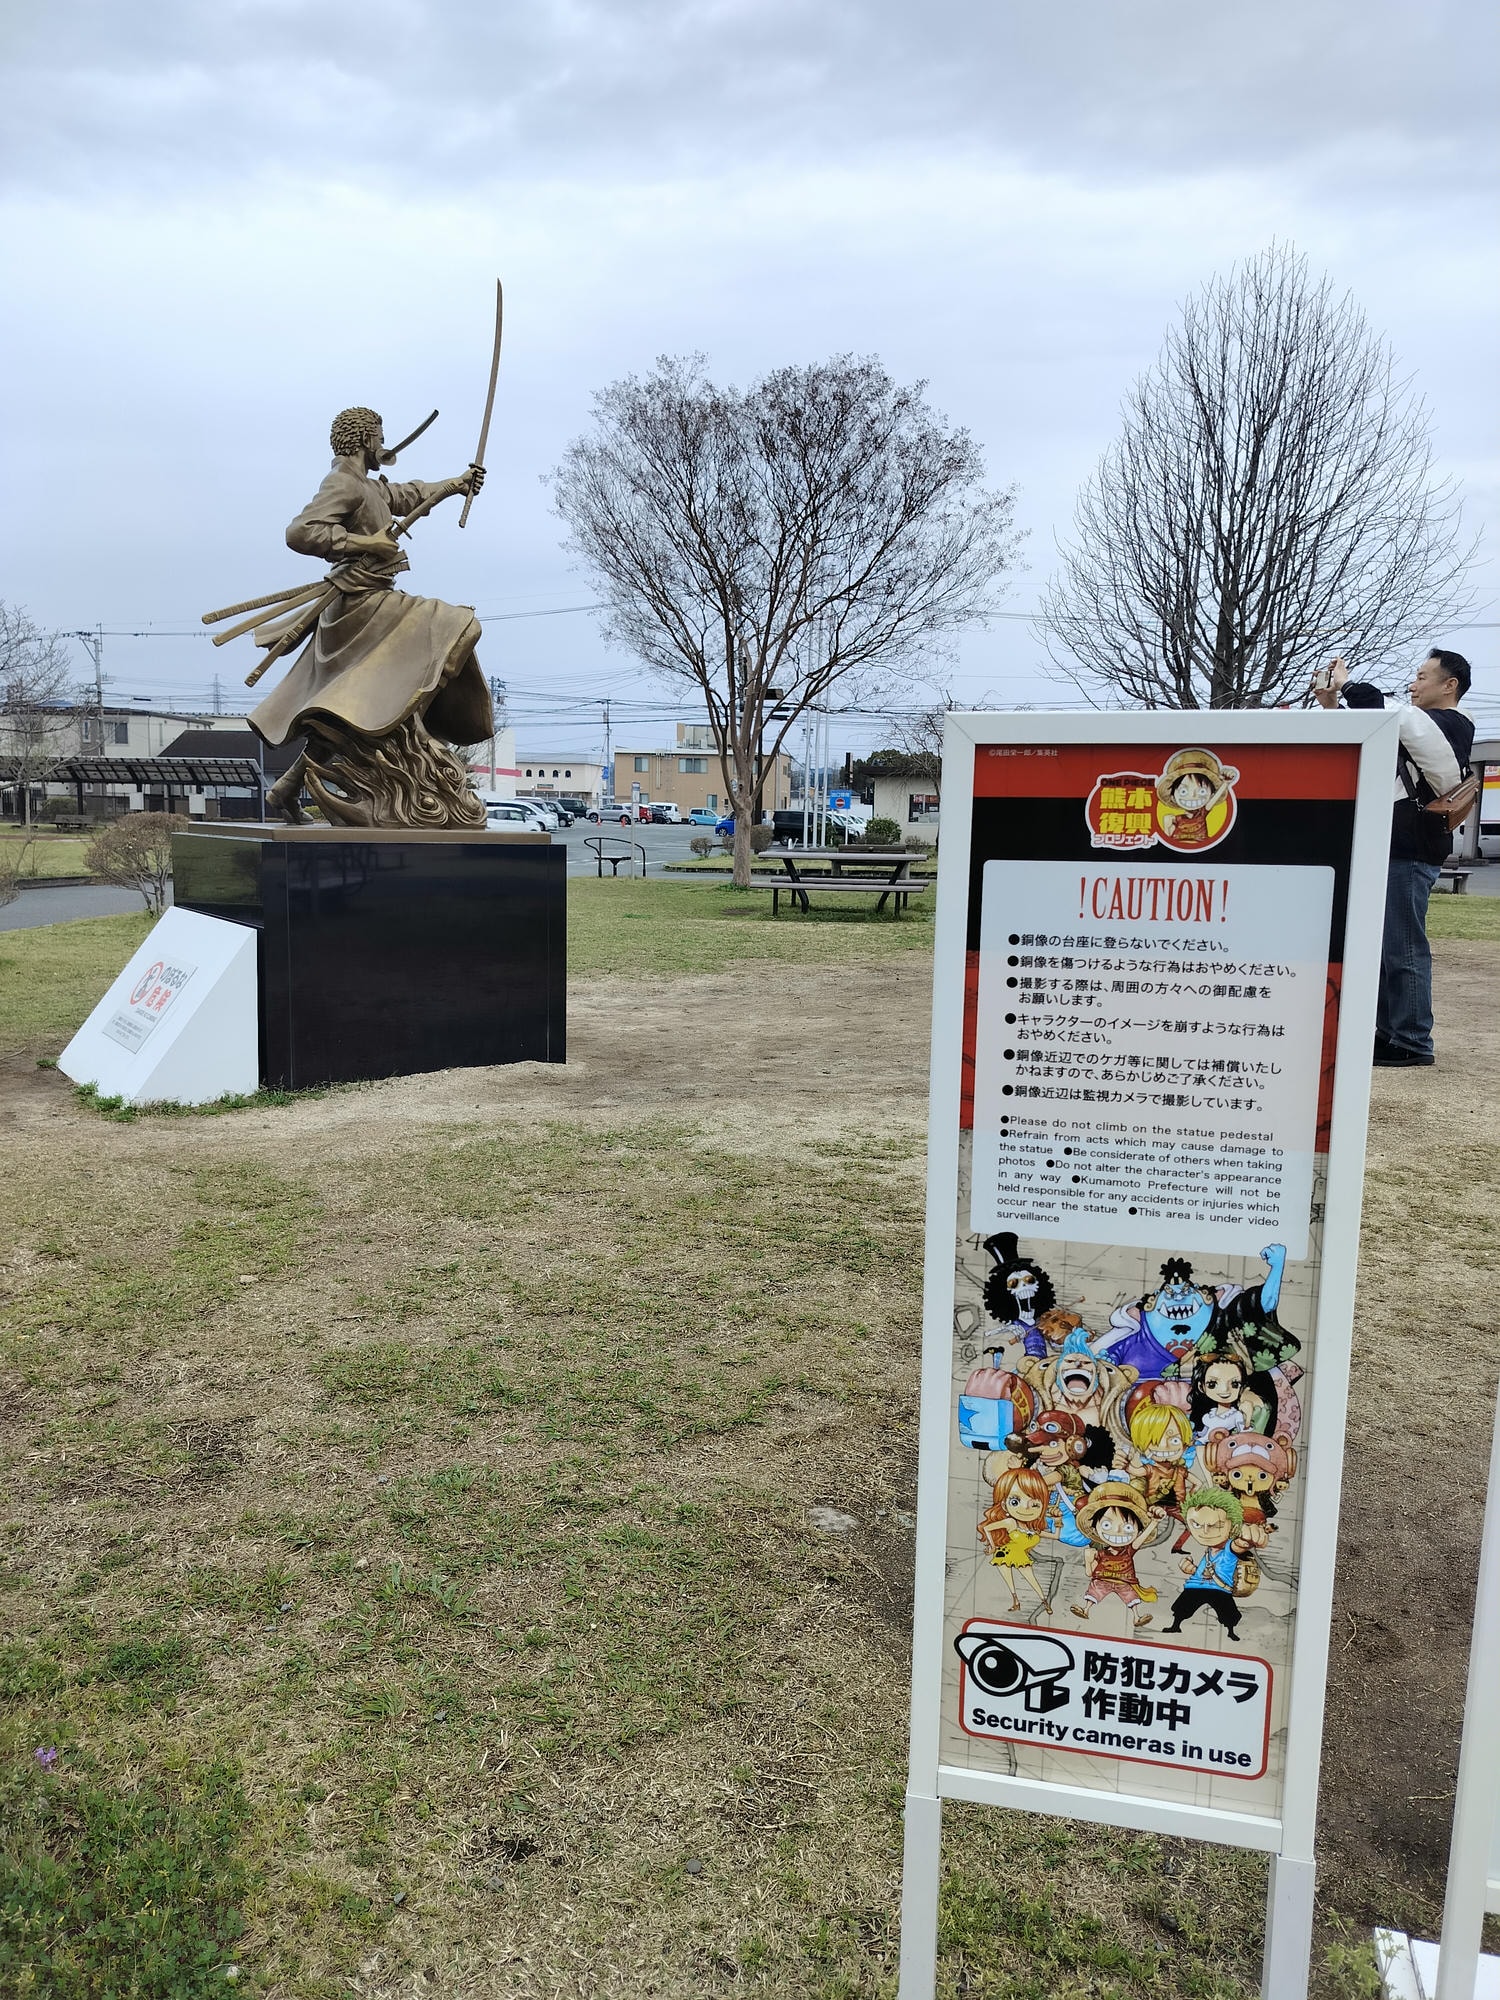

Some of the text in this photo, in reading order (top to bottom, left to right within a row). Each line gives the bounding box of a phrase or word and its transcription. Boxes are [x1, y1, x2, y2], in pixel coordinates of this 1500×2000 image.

[1100, 788, 1153, 809] 熊本
[1099, 813, 1152, 834] 復興
[1094, 834, 1155, 845] プロジェクト
[1010, 1116, 1273, 1141] Please do not climb on the statue pedestal
[1009, 1130, 1283, 1156] Refrain from acts which may cause damage to
[998, 1157, 1282, 1184] photos Do not alter the character's appearance
[1000, 1143, 1282, 1172] the statue Be considerate of others when taking
[998, 1169, 1280, 1198] in any way Kumamoto Prefecture will not be
[998, 1183, 1020, 1192] held
[1023, 1186, 1085, 1198] responsible
[1089, 1190, 1105, 1199] for
[1108, 1193, 1127, 1202] any
[1130, 1194, 1184, 1205] accidents
[1202, 1199, 1244, 1210] injuries
[1247, 1202, 1280, 1212] which
[996, 1211, 1060, 1222] surveillance
[997, 1198, 1279, 1226] occur near the statue This area is under video
[1083, 1651, 1259, 1703] 防犯カメラ
[1081, 1687, 1190, 1731] 作動中
[972, 1708, 1252, 1767] Security cameras in use
